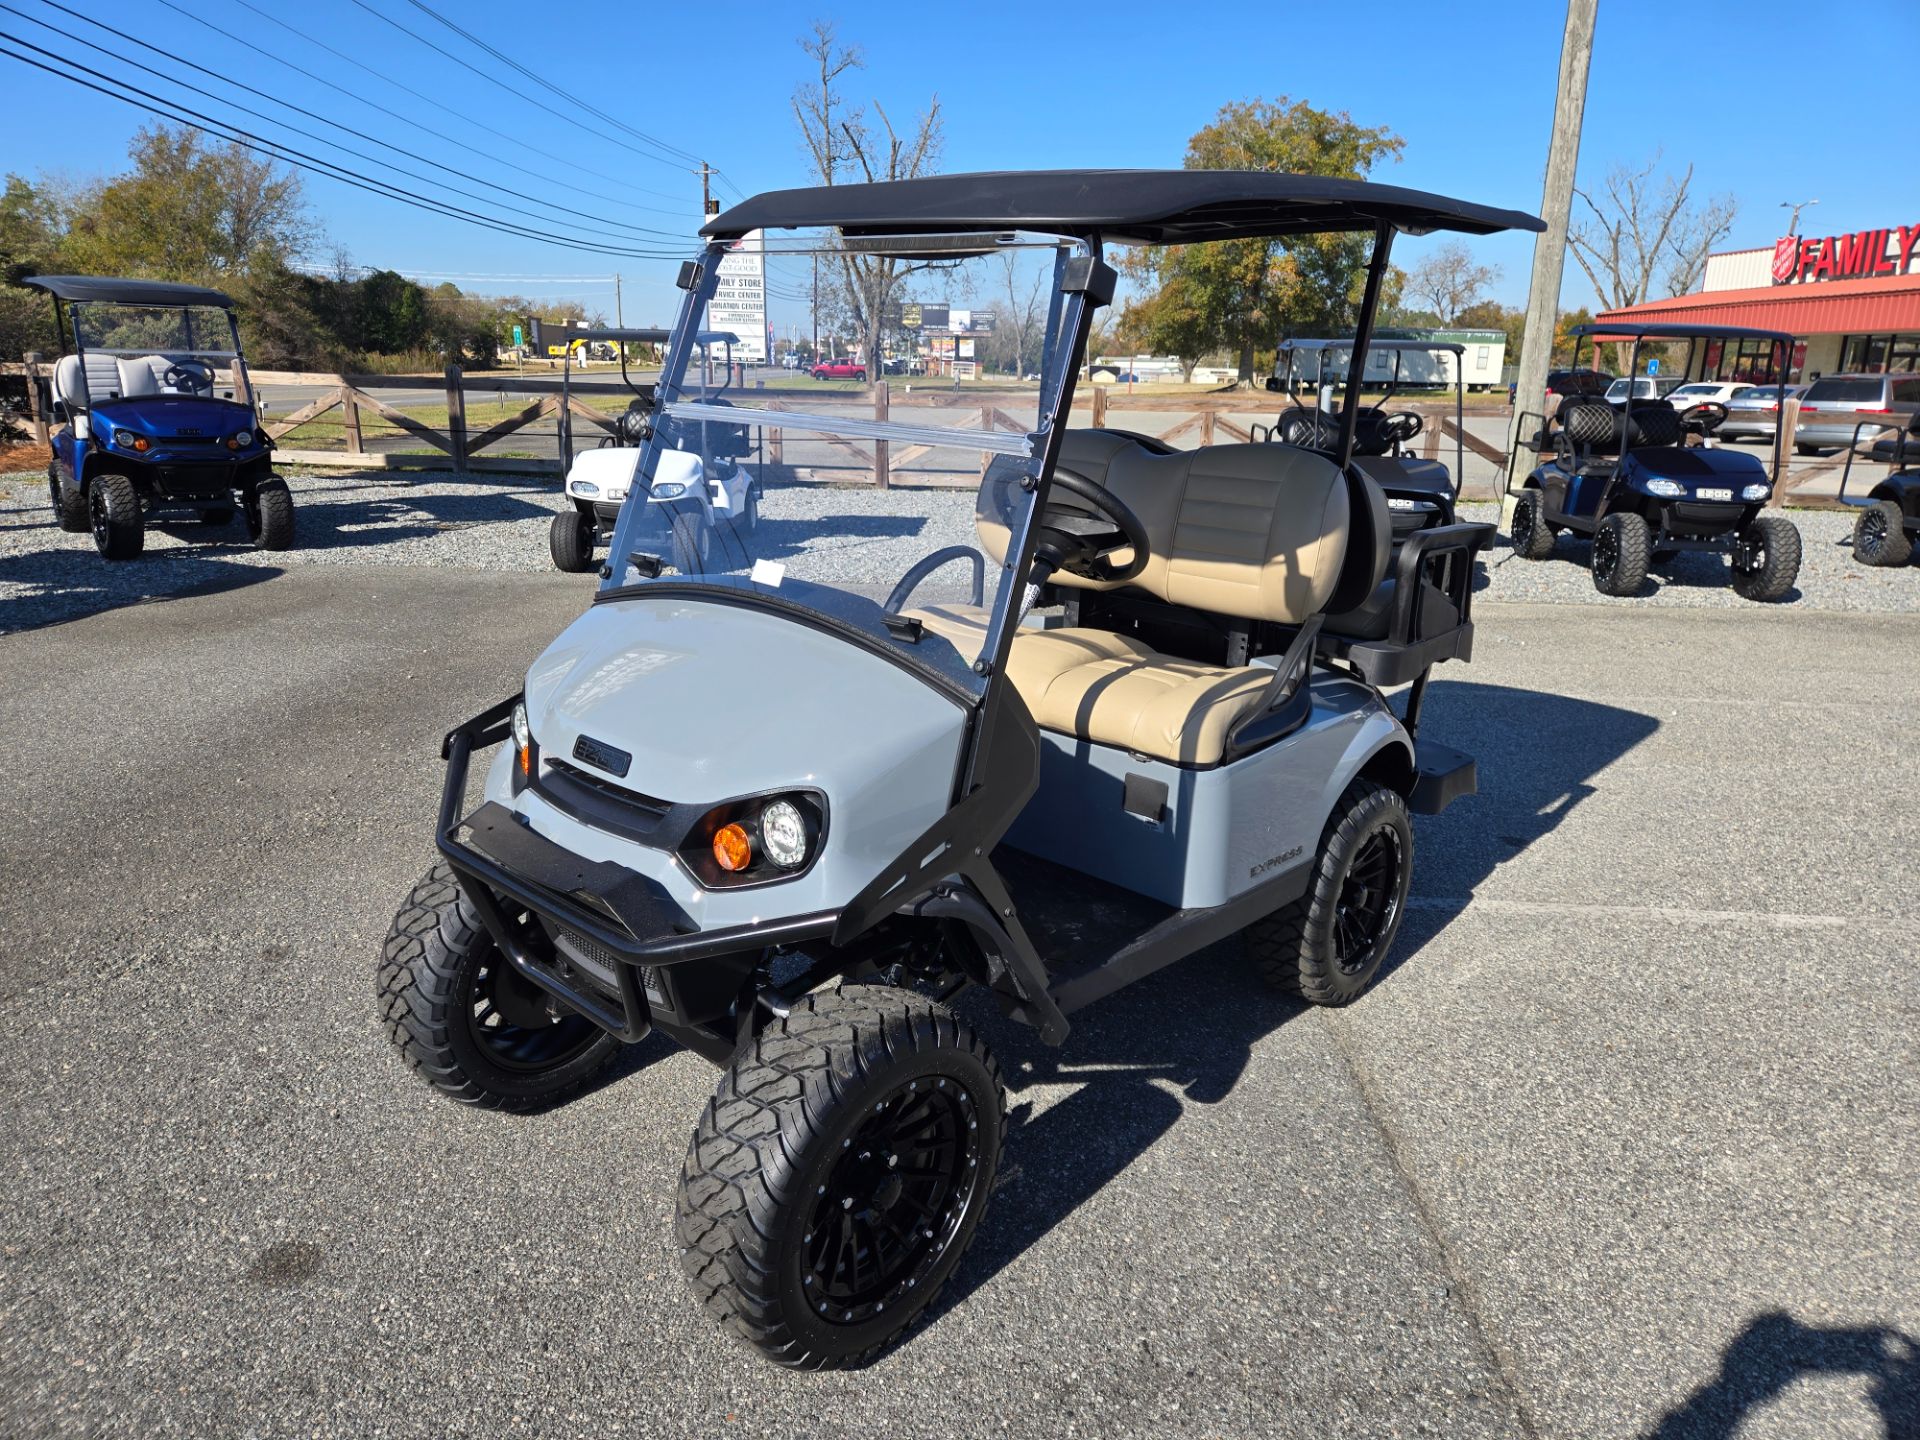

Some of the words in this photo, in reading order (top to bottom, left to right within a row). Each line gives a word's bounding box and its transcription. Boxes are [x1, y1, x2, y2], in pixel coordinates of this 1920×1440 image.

[1797, 224, 1920, 280] FAMILY
[738, 278, 762, 288] STORE
[737, 291, 761, 299] CENTER
[710, 302, 740, 310] DONATION
[741, 303, 764, 311] CENTER
[1249, 845, 1304, 878] EXPRESS
